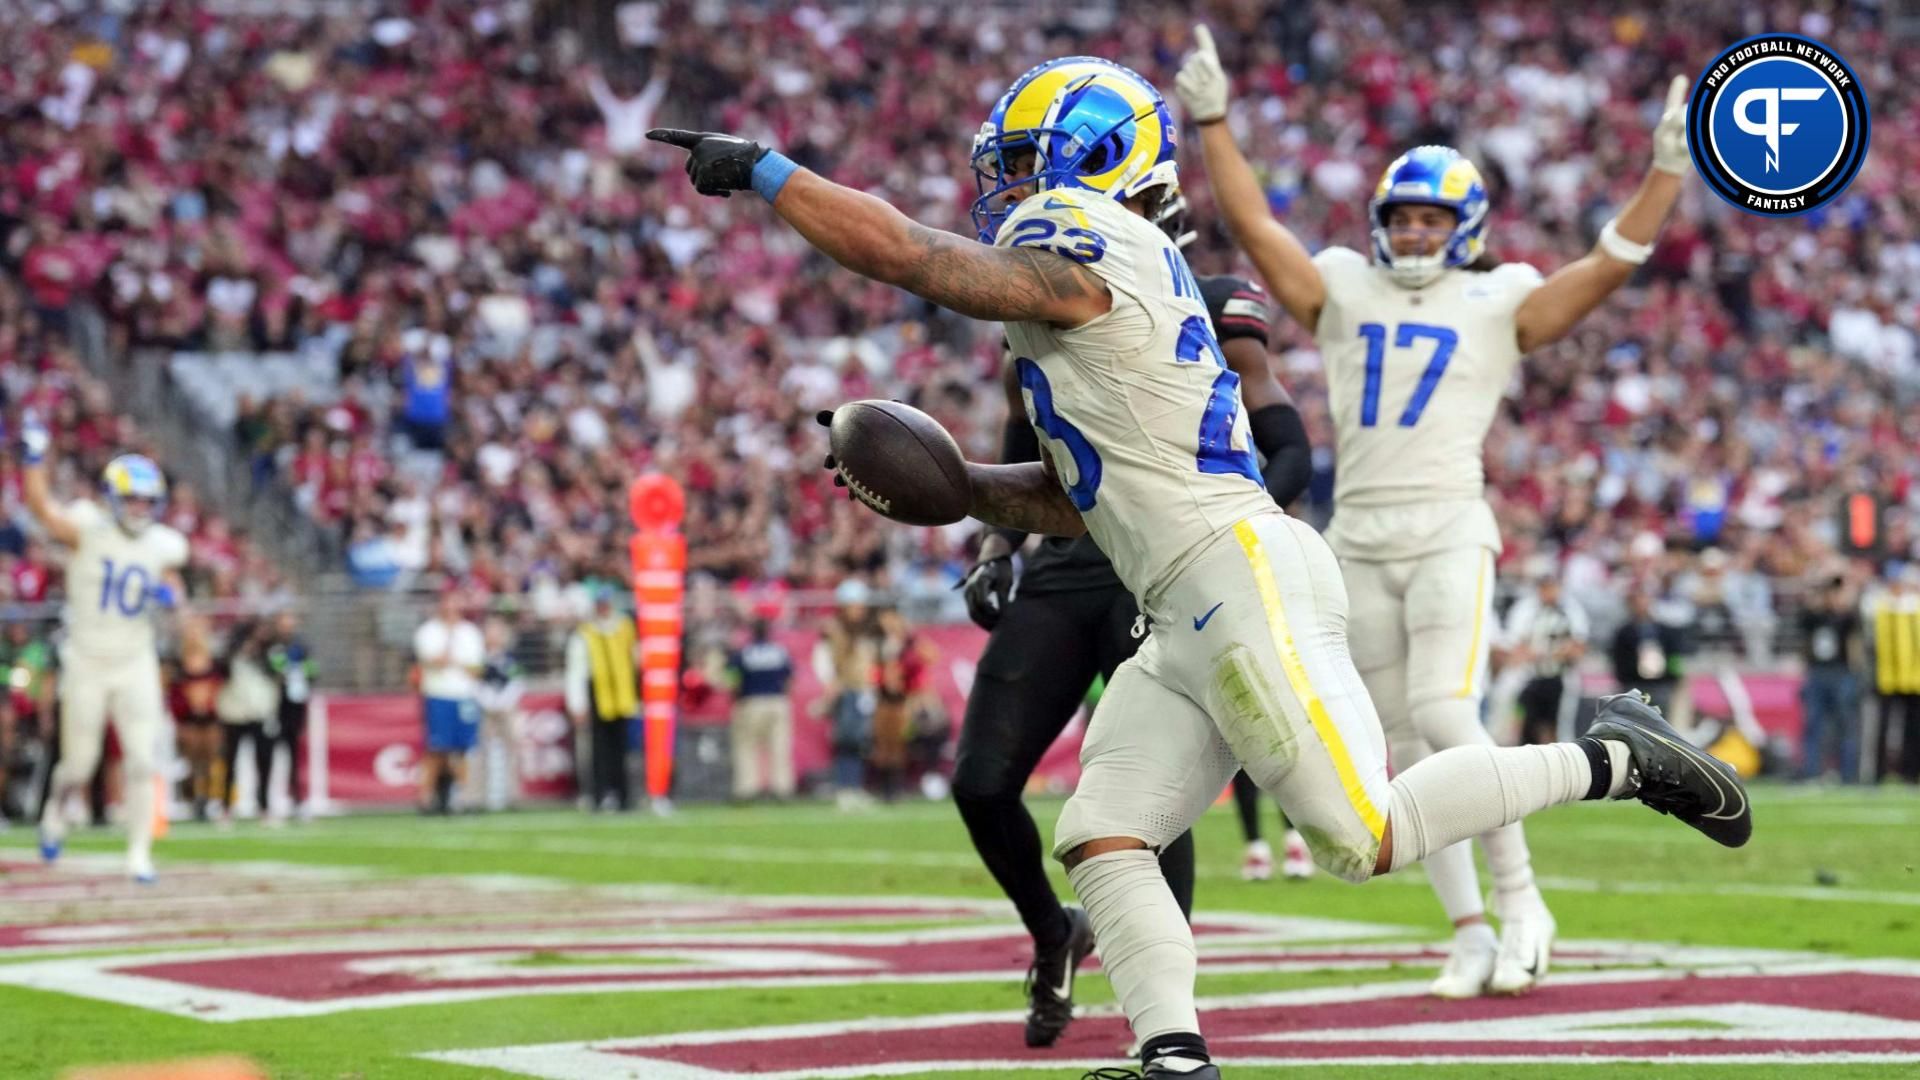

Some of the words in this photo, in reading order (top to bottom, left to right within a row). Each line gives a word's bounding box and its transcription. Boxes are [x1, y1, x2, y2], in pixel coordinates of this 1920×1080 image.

[1011, 217, 1108, 265] 23
[1358, 322, 1459, 427] 17
[99, 556, 149, 619] 10
